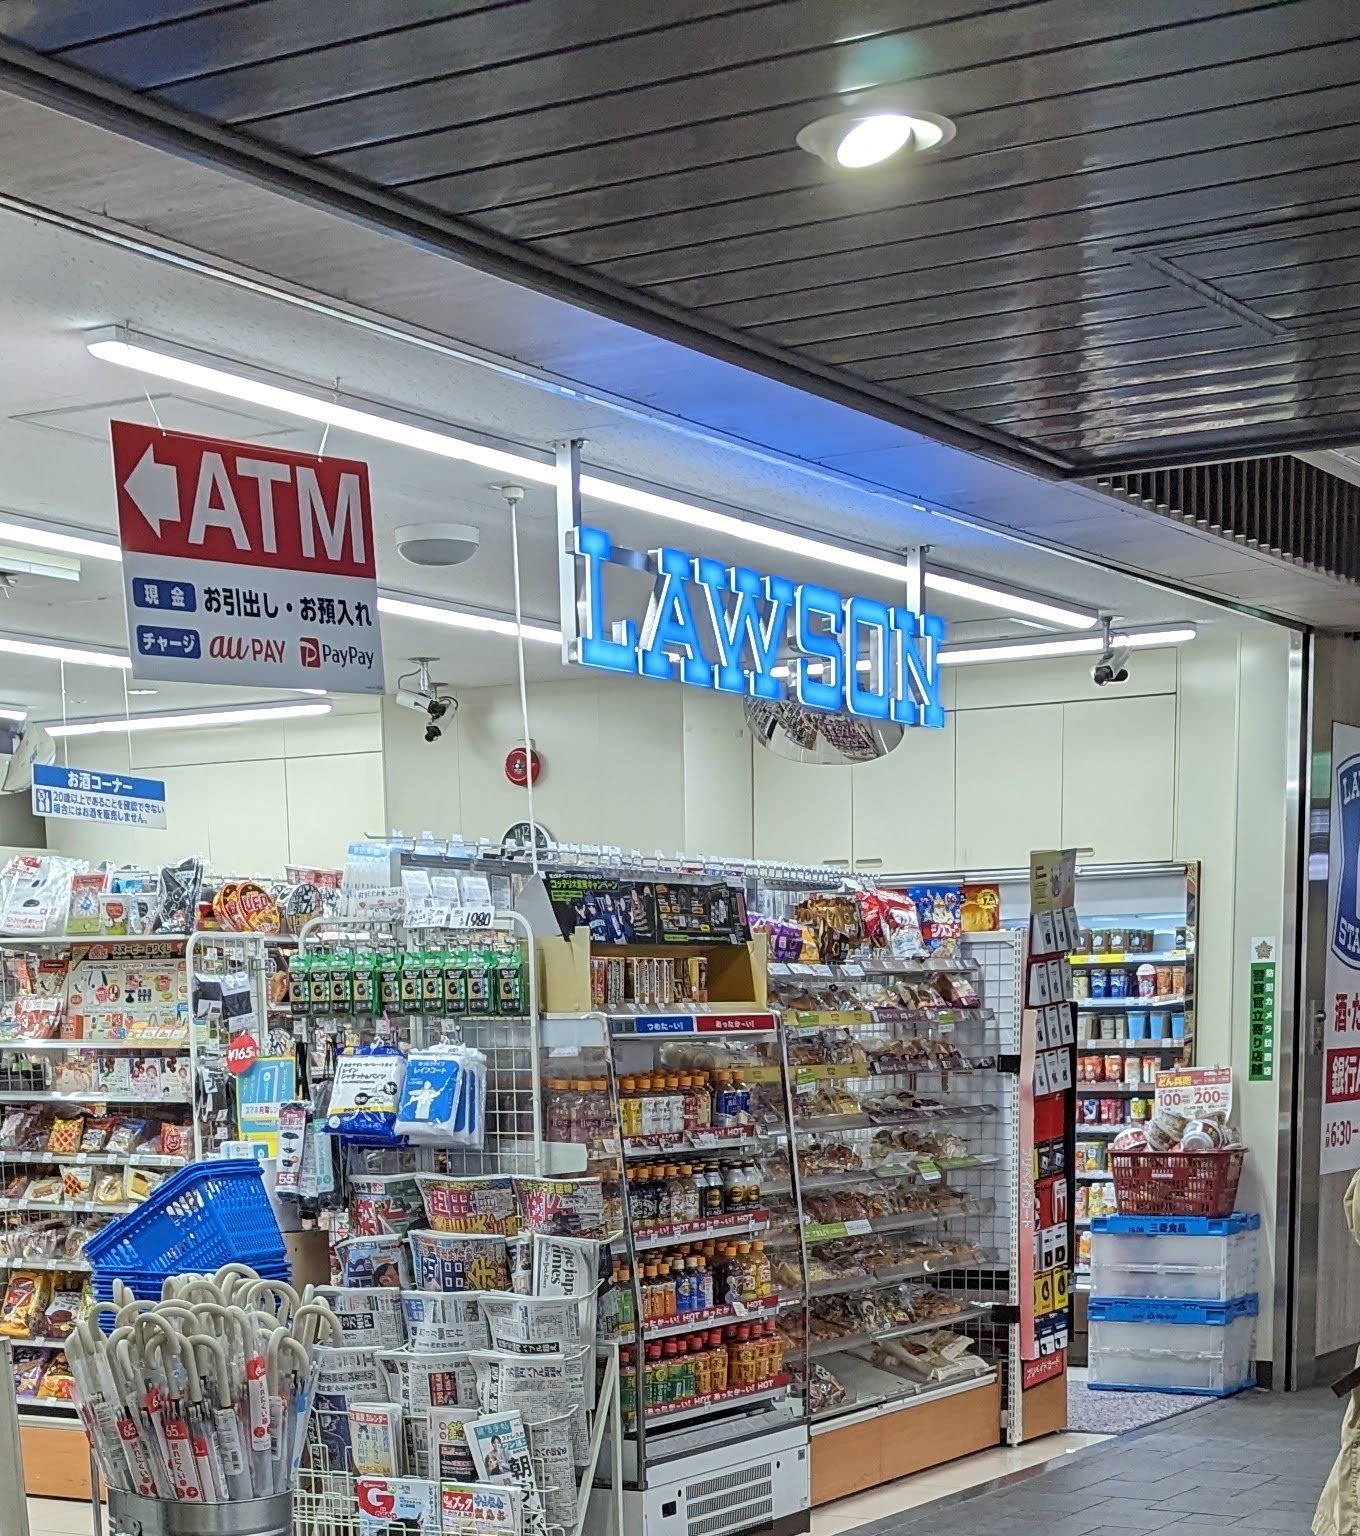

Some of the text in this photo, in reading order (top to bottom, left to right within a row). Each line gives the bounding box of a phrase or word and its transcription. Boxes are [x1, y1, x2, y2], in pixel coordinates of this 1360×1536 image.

[187, 450, 367, 565] ATM
[143, 583, 373, 627] 現金 お引出し・お預入れ
[573, 524, 946, 729] LAWSON
[142, 632, 375, 669] チャージ au PAY PayPay
[67, 770, 133, 793] お酒コーナー
[757, 1379, 774, 1390] HOT
